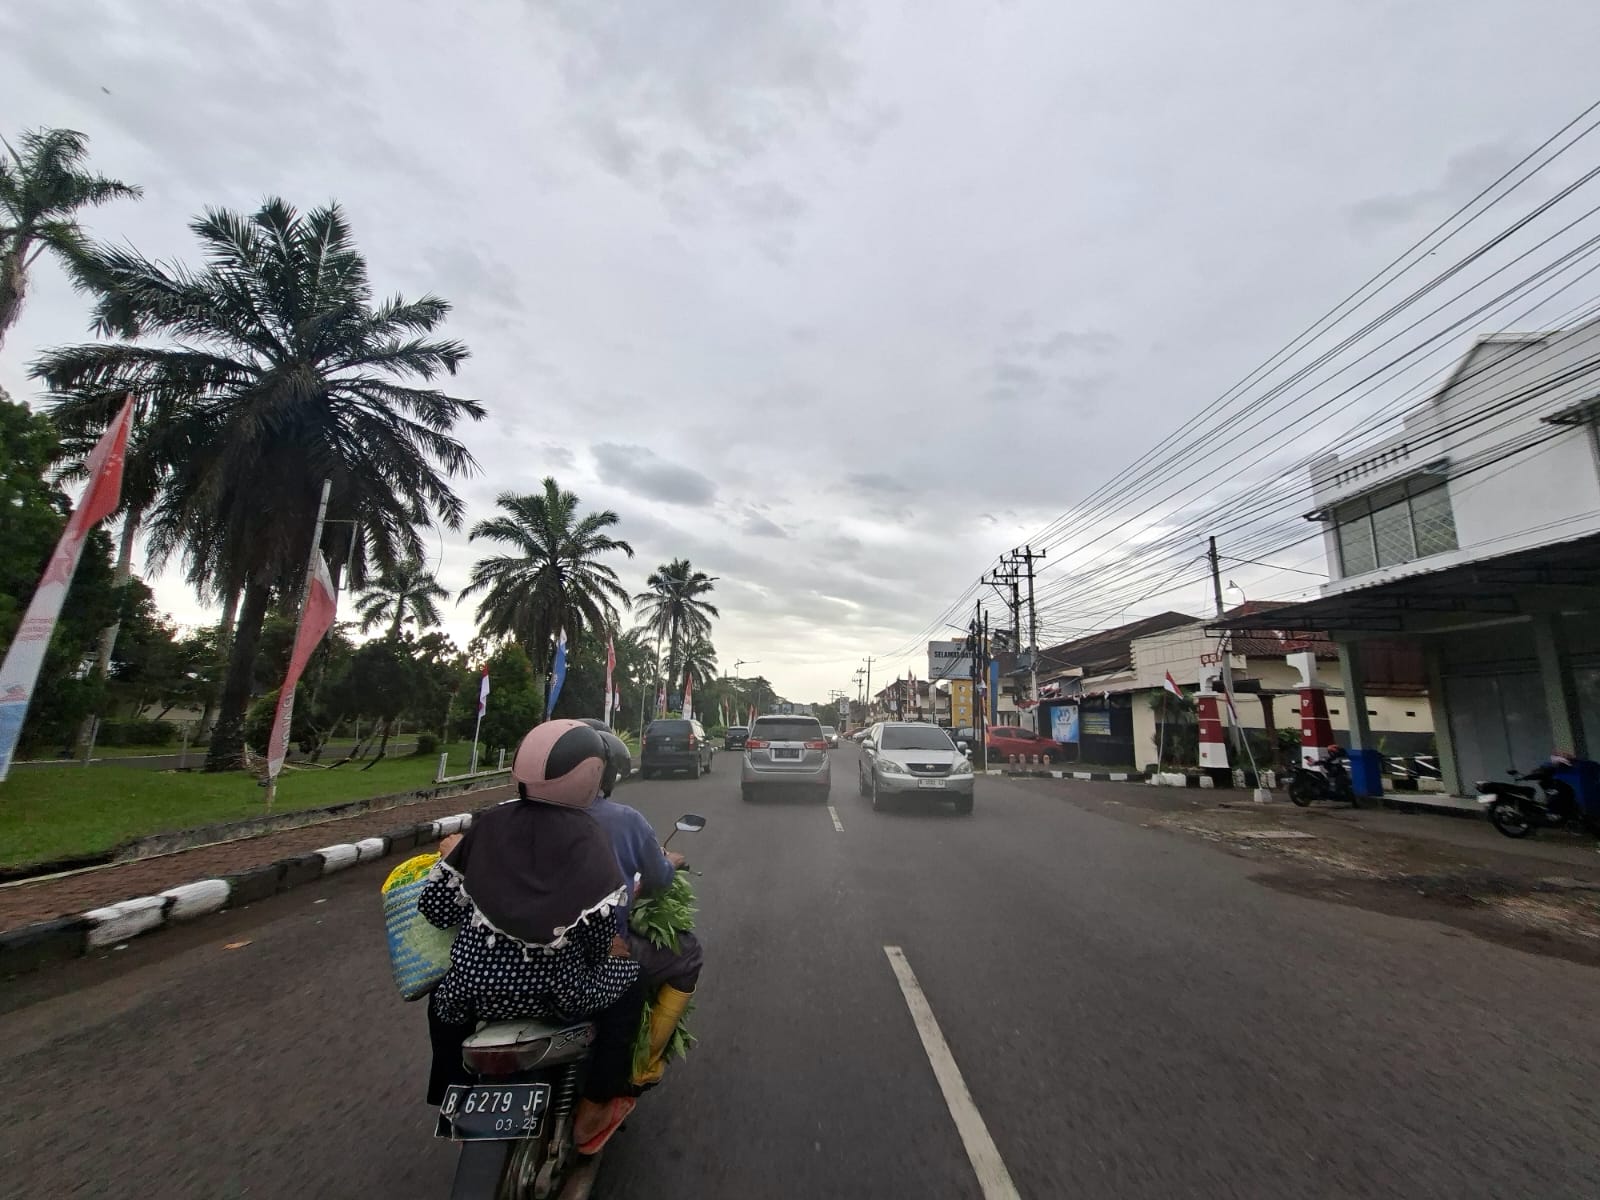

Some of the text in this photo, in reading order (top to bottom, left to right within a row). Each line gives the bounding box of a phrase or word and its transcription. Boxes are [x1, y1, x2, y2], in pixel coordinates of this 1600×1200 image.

[446, 1090, 544, 1114] B 6279 JF
